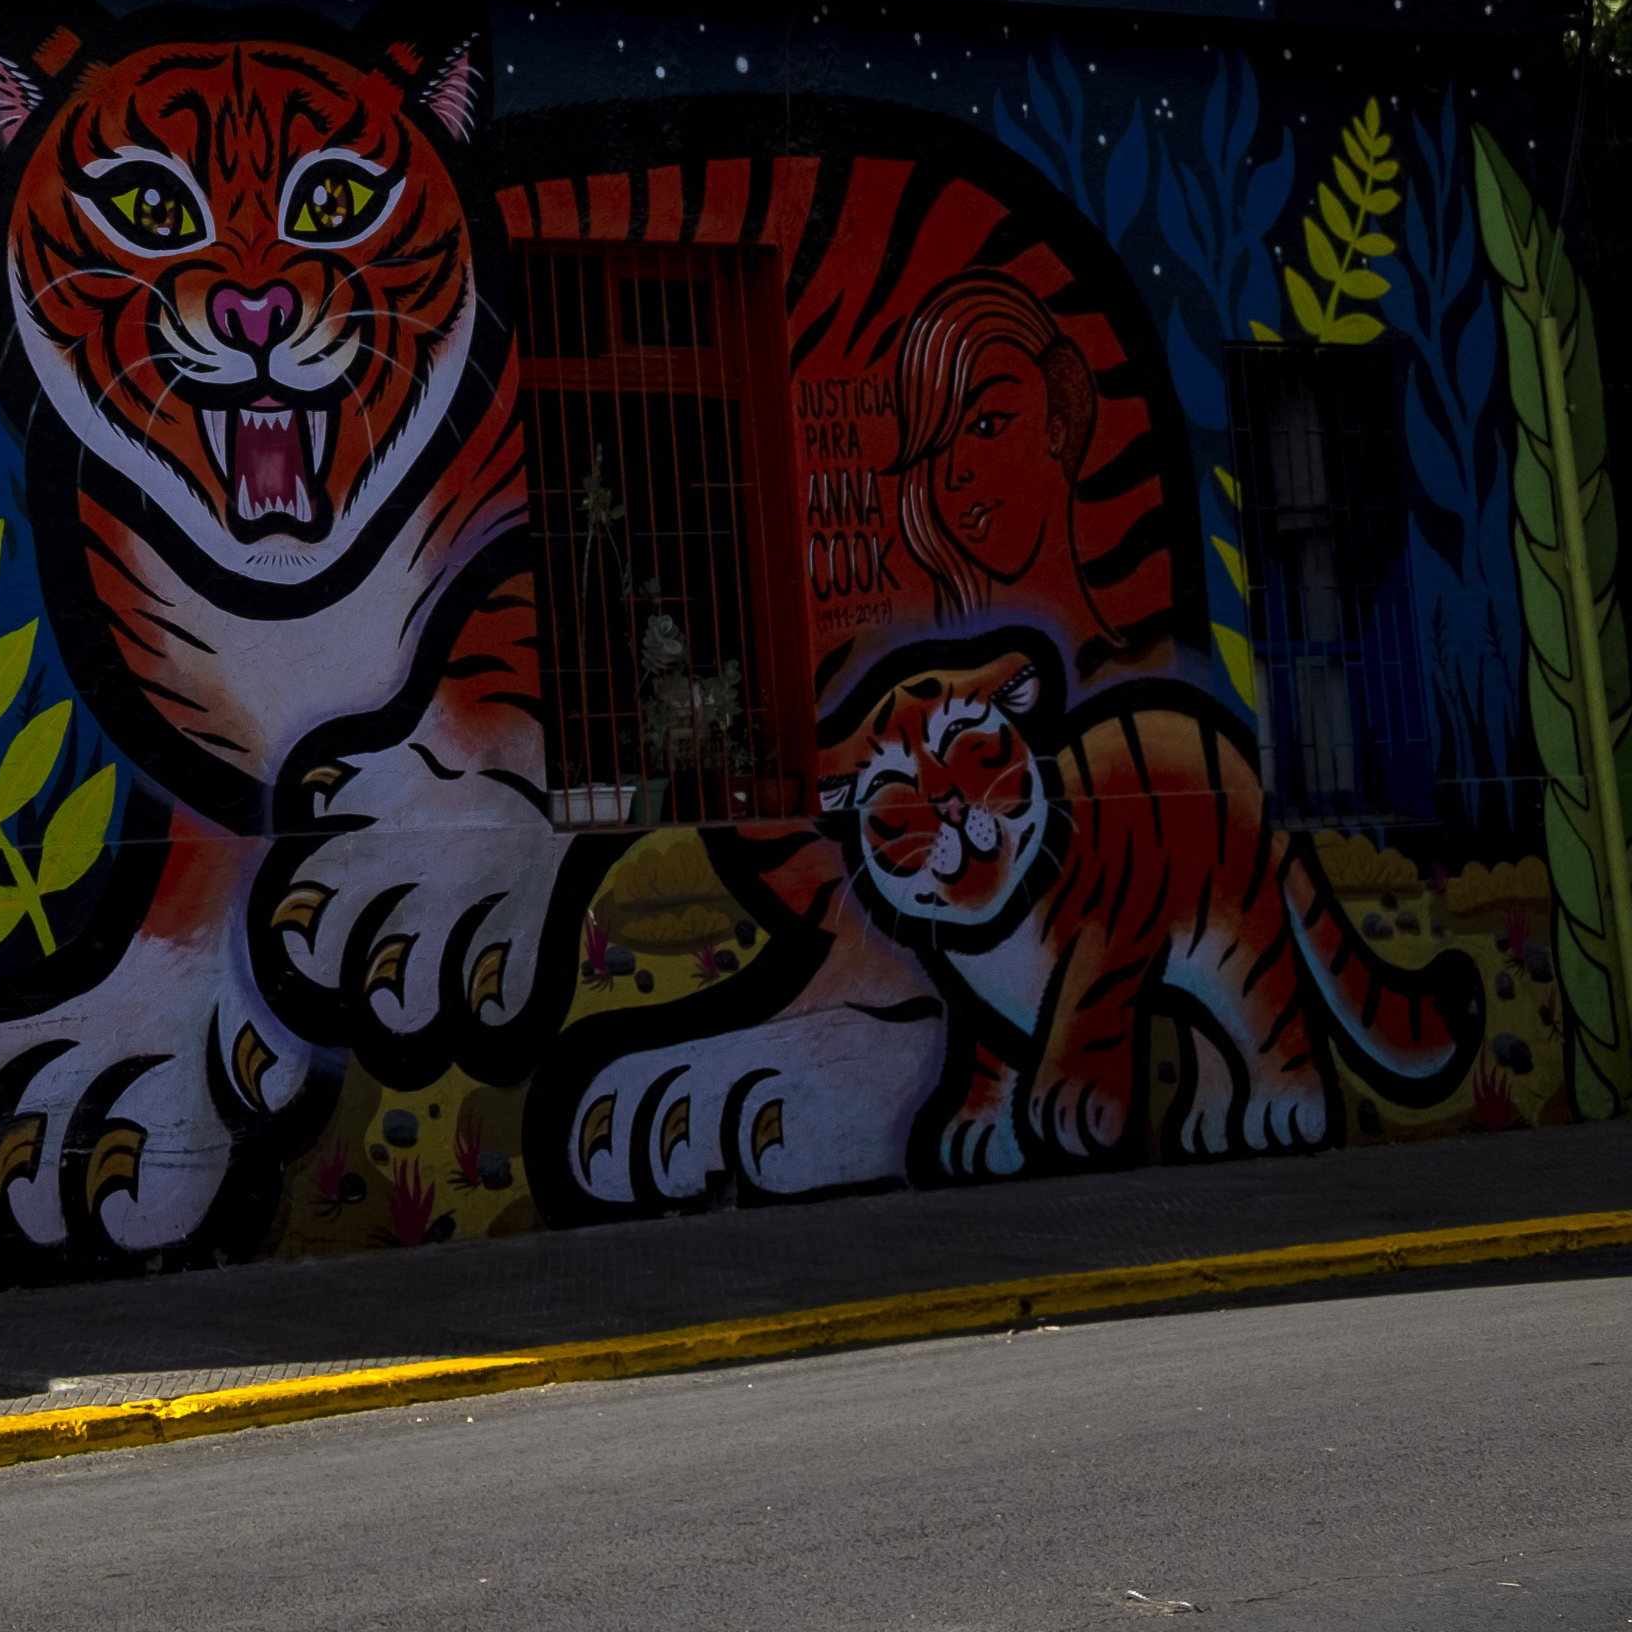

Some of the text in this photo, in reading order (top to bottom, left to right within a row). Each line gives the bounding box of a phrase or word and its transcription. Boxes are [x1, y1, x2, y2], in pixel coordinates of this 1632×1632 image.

[805, 421, 863, 459] PARA
[808, 467, 884, 527] ANNA
[809, 531, 901, 601] COOK
